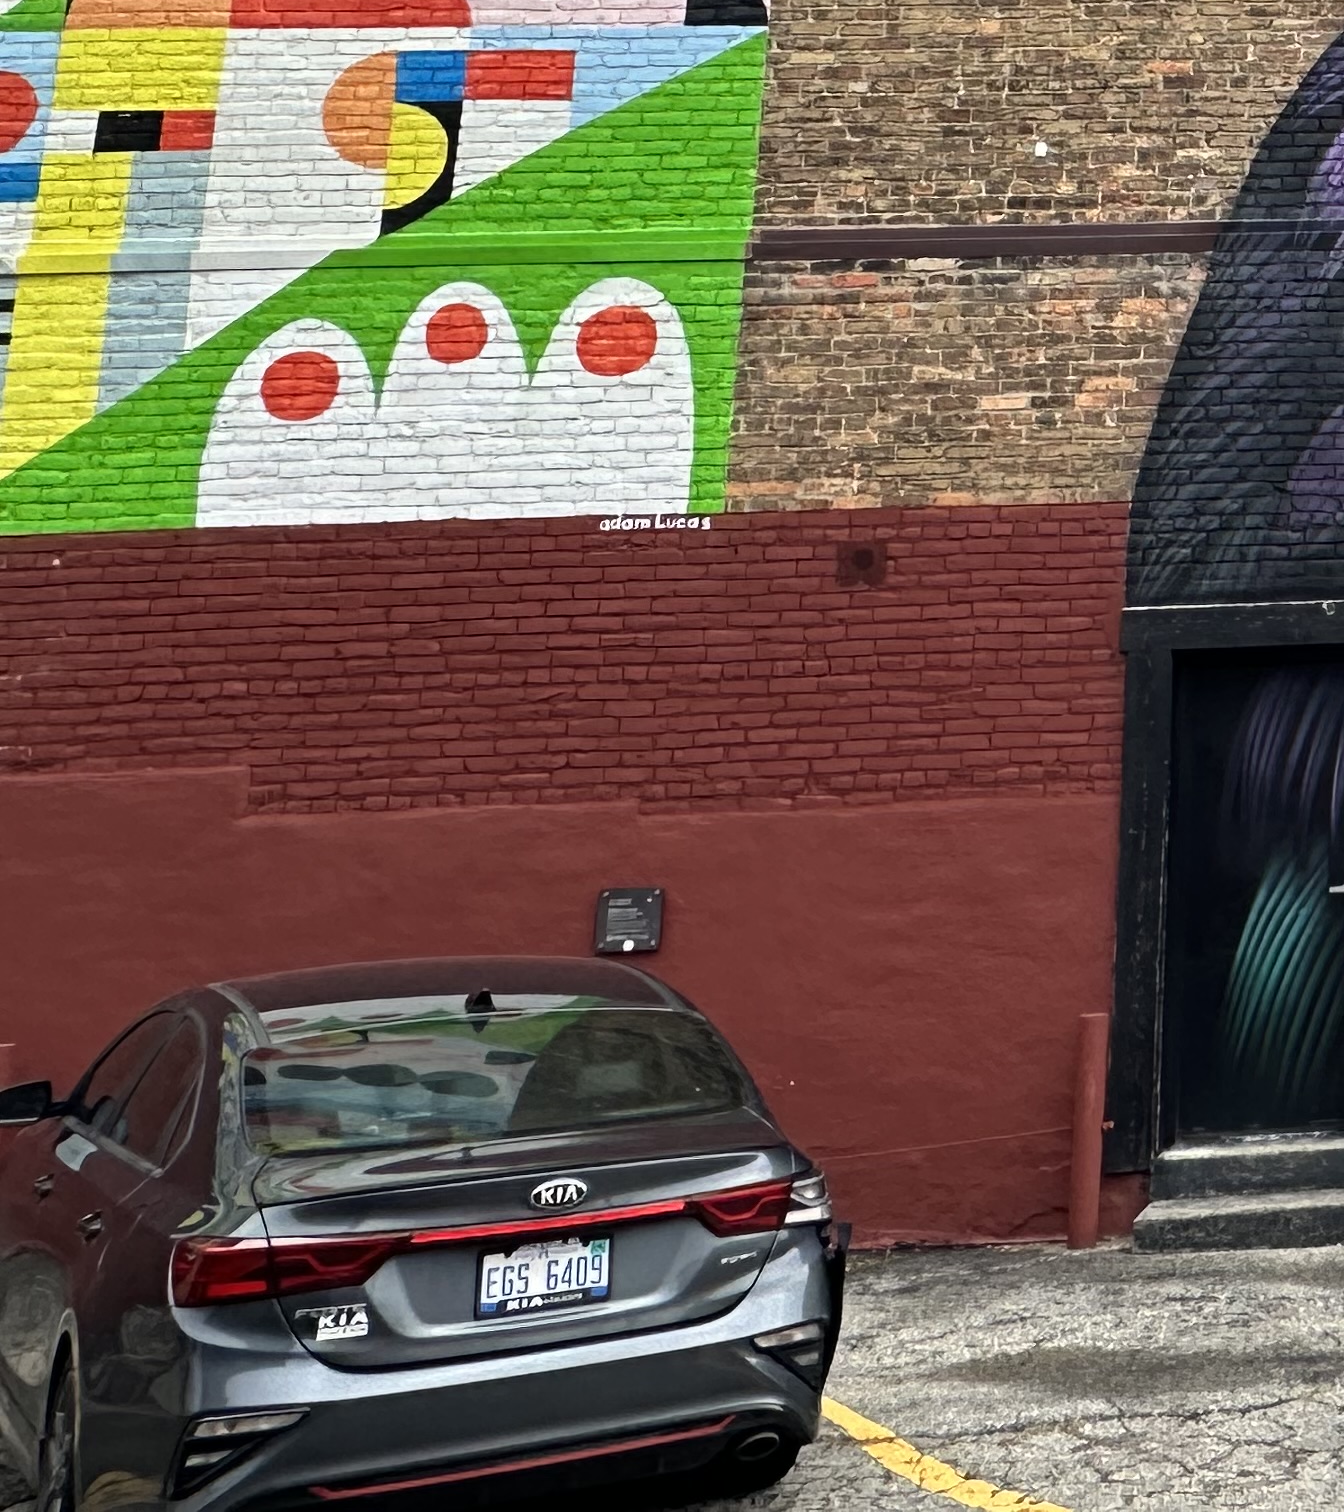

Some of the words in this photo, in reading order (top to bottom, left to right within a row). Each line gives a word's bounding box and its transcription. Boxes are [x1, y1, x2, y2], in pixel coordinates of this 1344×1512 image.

[600, 515, 651, 531] adam
[655, 514, 711, 530] Lucas
[541, 1184, 577, 1205] KIA
[486, 1262, 529, 1299] EGS
[546, 1254, 603, 1291] 6409
[506, 1296, 543, 1311] KIA
